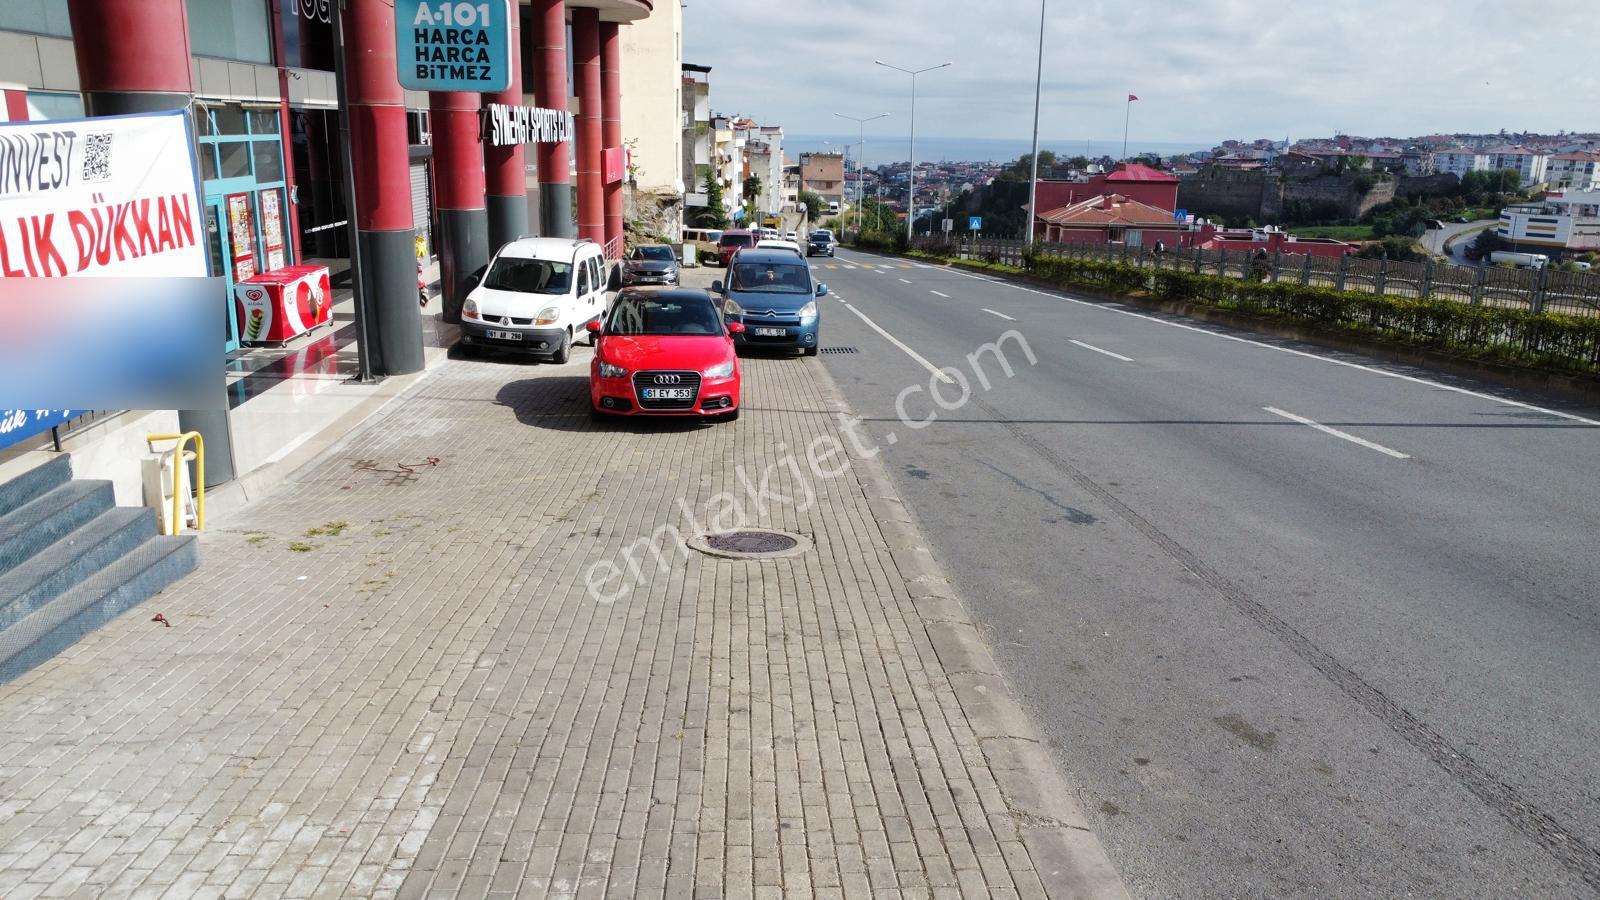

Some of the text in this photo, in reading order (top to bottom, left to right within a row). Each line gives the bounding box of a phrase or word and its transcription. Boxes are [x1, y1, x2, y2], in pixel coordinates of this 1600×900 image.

[414, 28, 489, 45] HARCA
[415, 46, 490, 63] HARCA
[491, 103, 573, 146] SYNERGY SPORTS CLUB
[67, 192, 195, 272] DÜKKAN
[647, 389, 690, 398] 61 EY 353
